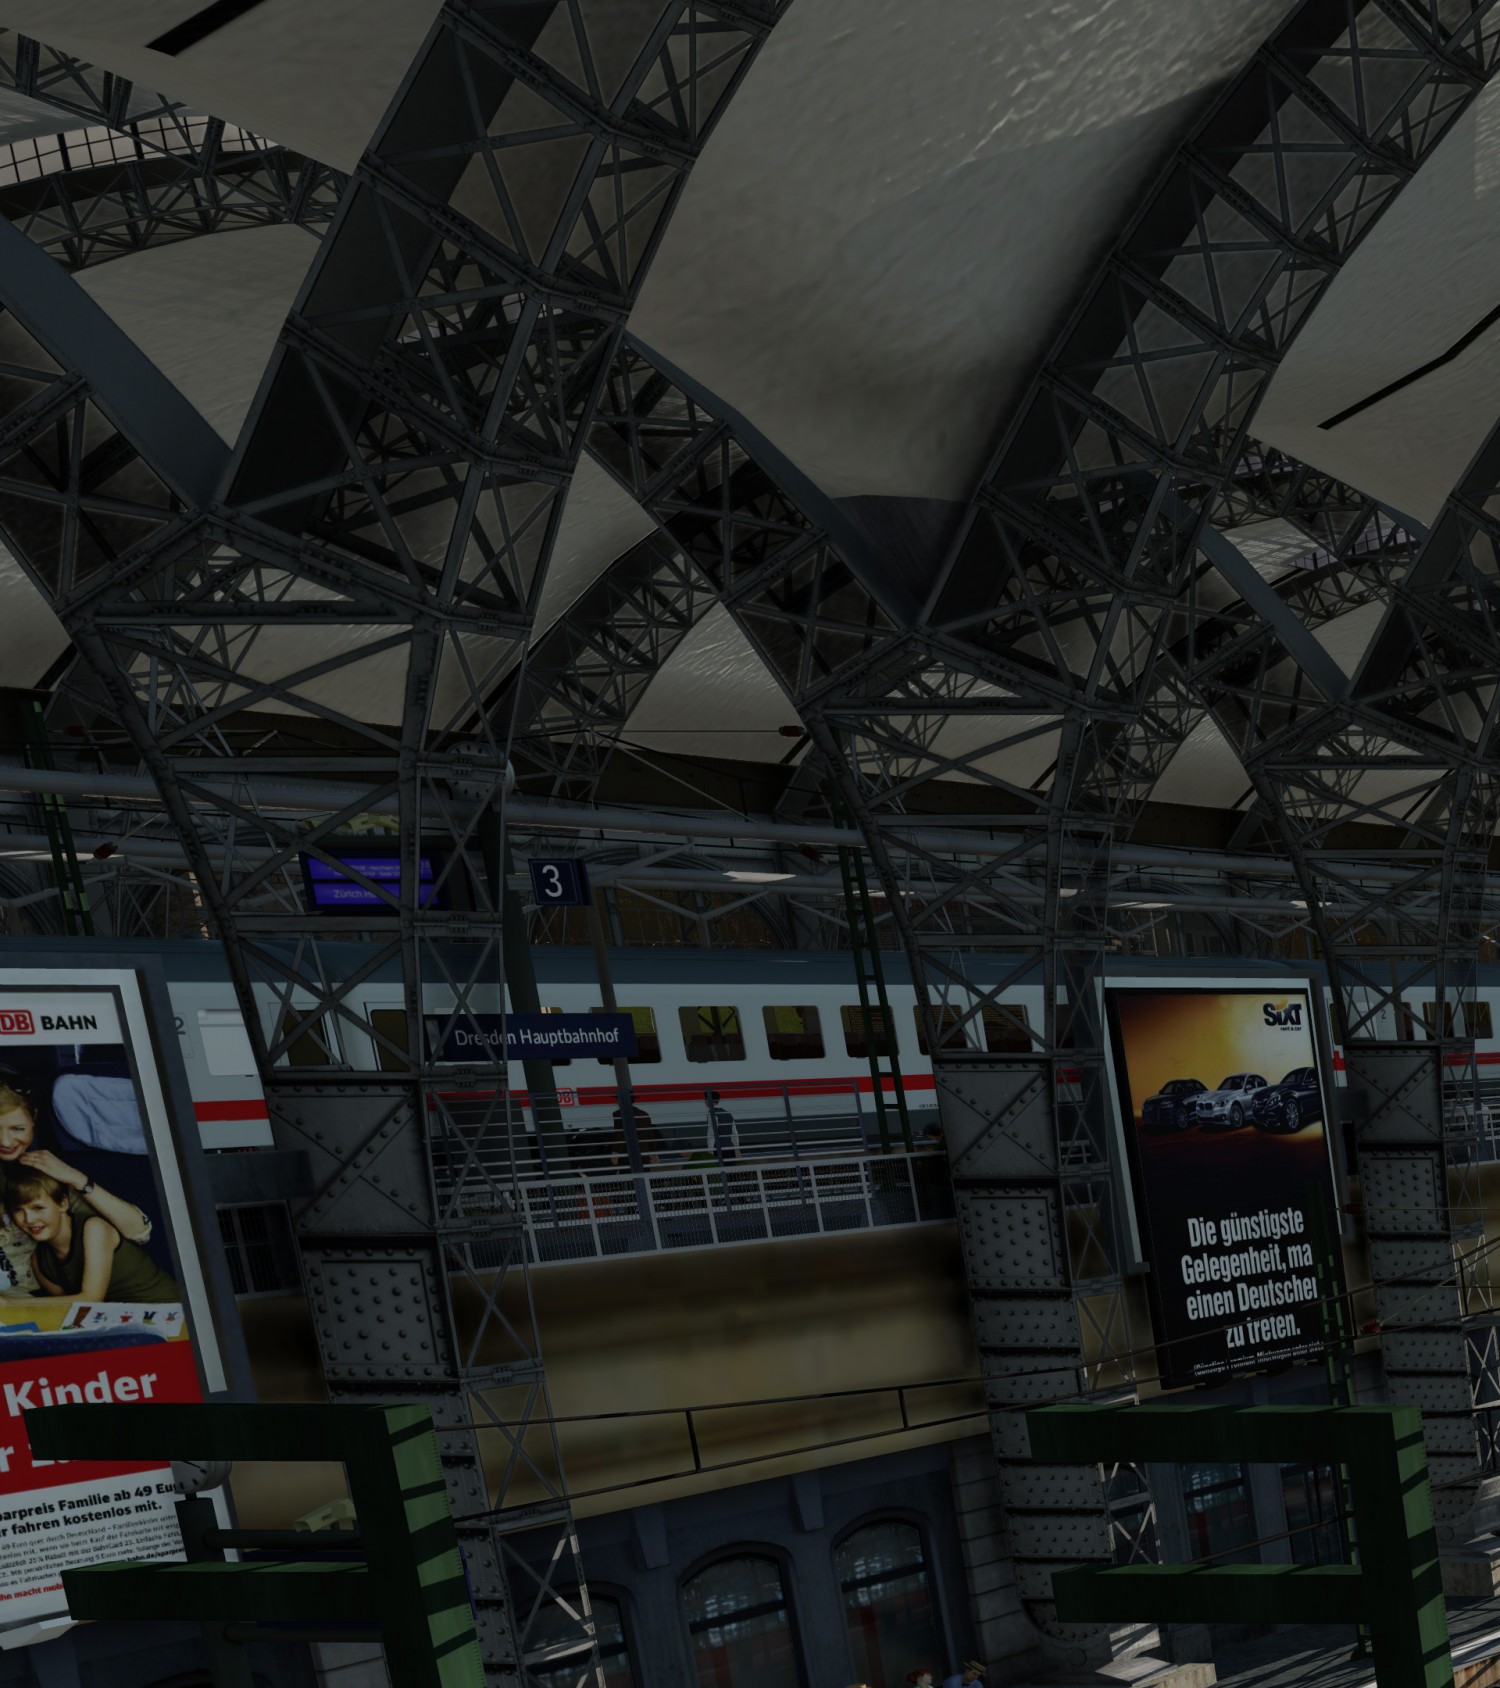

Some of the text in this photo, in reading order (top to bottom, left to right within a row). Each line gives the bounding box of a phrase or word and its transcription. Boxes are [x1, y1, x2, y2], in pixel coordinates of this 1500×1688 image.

[334, 887, 363, 899] Zürich
[542, 864, 563, 897] 3
[0, 1012, 97, 1032] DB BAHN
[519, 1026, 620, 1047] Hauptbahnhof
[1187, 1207, 1304, 1247] Die günstigste
[1181, 1243, 1313, 1285] Gelegenheit, ma
[1186, 1290, 1235, 1321] einen
[1226, 1313, 1301, 1349] zu treten.
[4, 1371, 158, 1417] Kinder
[59, 1494, 110, 1511] Familie
[114, 1489, 131, 1502] ab
[135, 1485, 152, 1498] 49
[156, 1483, 176, 1494] Eu
[12, 1519, 60, 1535] fahren
[63, 1506, 131, 1526] kostenlos
[135, 1500, 162, 1513] mit.
